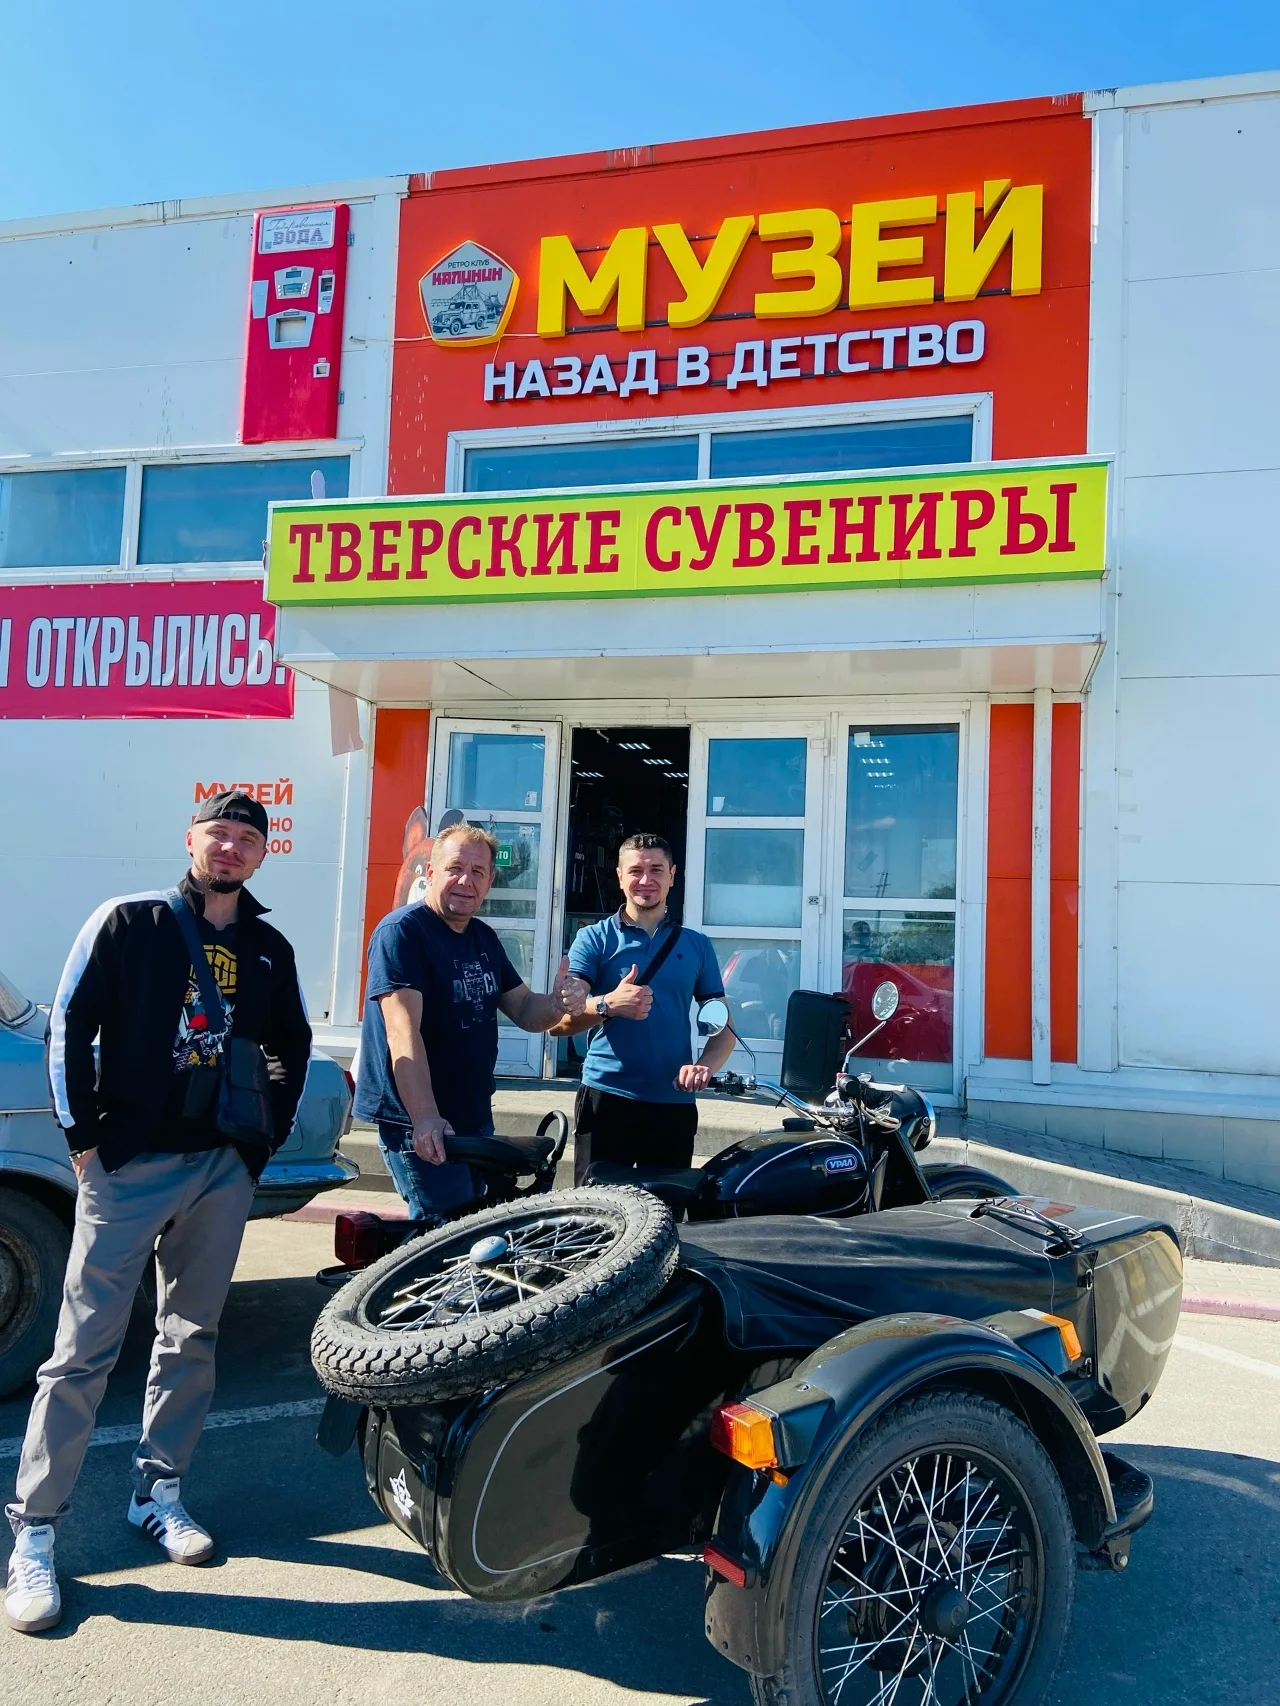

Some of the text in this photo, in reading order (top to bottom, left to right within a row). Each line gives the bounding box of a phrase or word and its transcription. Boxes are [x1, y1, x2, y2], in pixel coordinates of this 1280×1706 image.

[273, 228, 323, 245] ВОДА
[536, 179, 1043, 338] МУЗЕЙ
[448, 259, 490, 269] РЕТРО КЛУБ
[484, 320, 985, 401] НАЗАД В ДЕТСТВО
[289, 482, 1077, 583] ТВЕРСКИЕ СУВЕНИРЫ
[830, 1158, 853, 1169] УРАЛ
